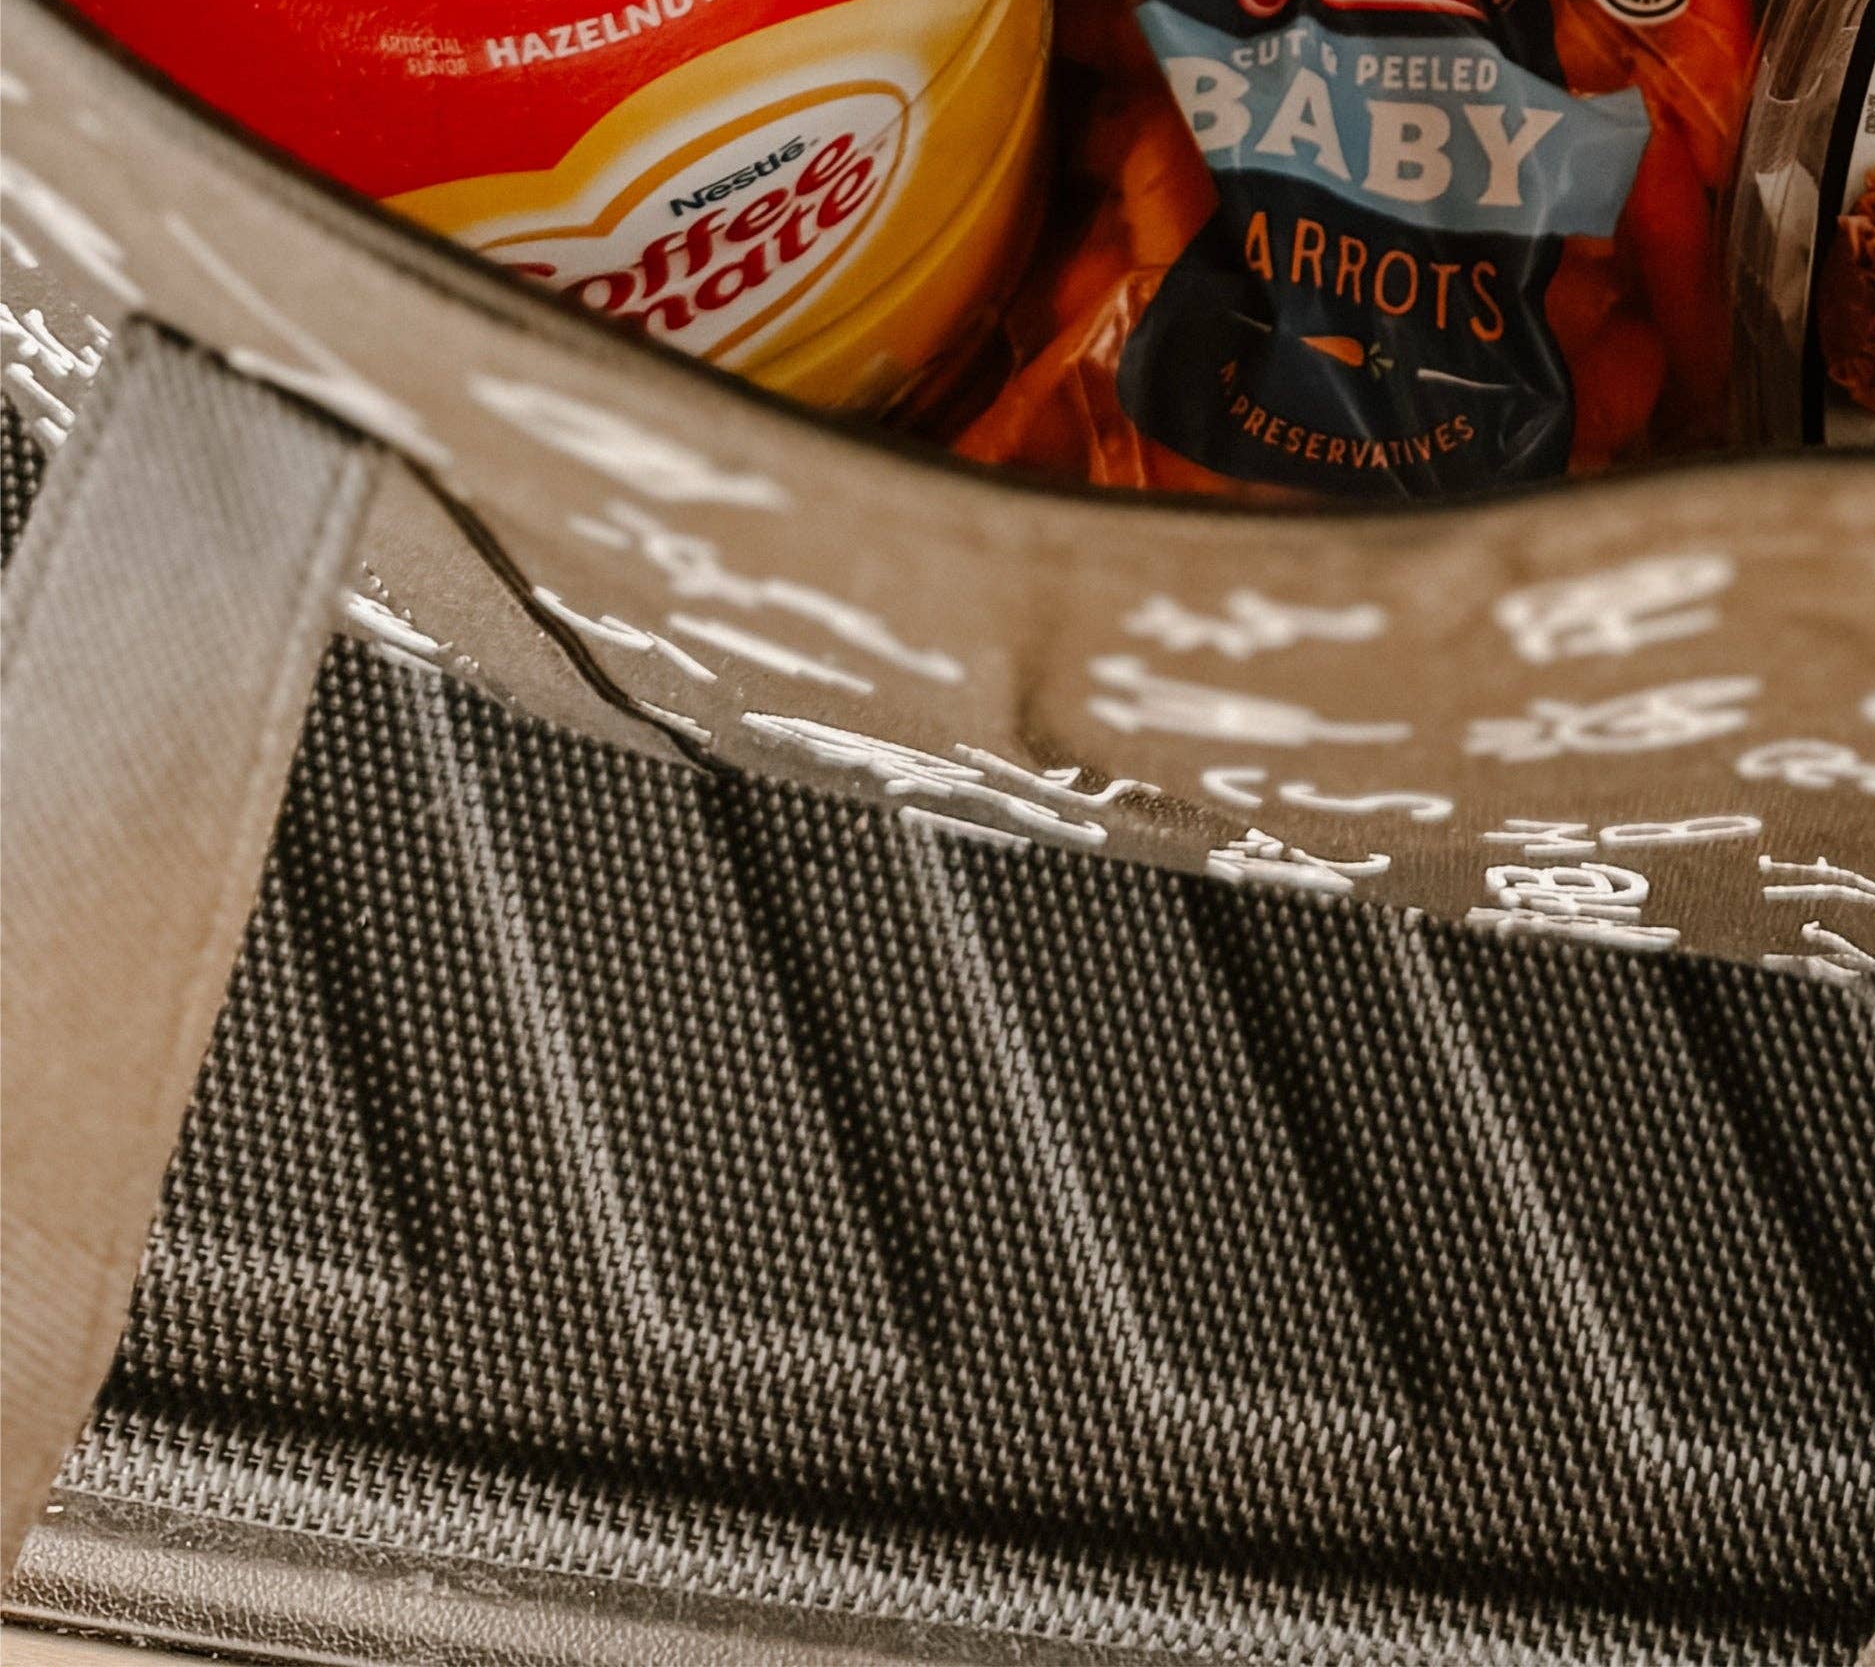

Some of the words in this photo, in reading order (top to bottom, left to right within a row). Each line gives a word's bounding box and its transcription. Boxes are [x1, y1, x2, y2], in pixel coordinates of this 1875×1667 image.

[1232, 30, 1308, 68] CUT
[1356, 55, 1498, 92] PEELED
[670, 136, 809, 219] Nestlé
[1166, 56, 1565, 208] BABY
[503, 133, 858, 317] offee
[1245, 210, 1503, 342] ARROTS
[1229, 393, 1476, 470] PRESERVATIVES
